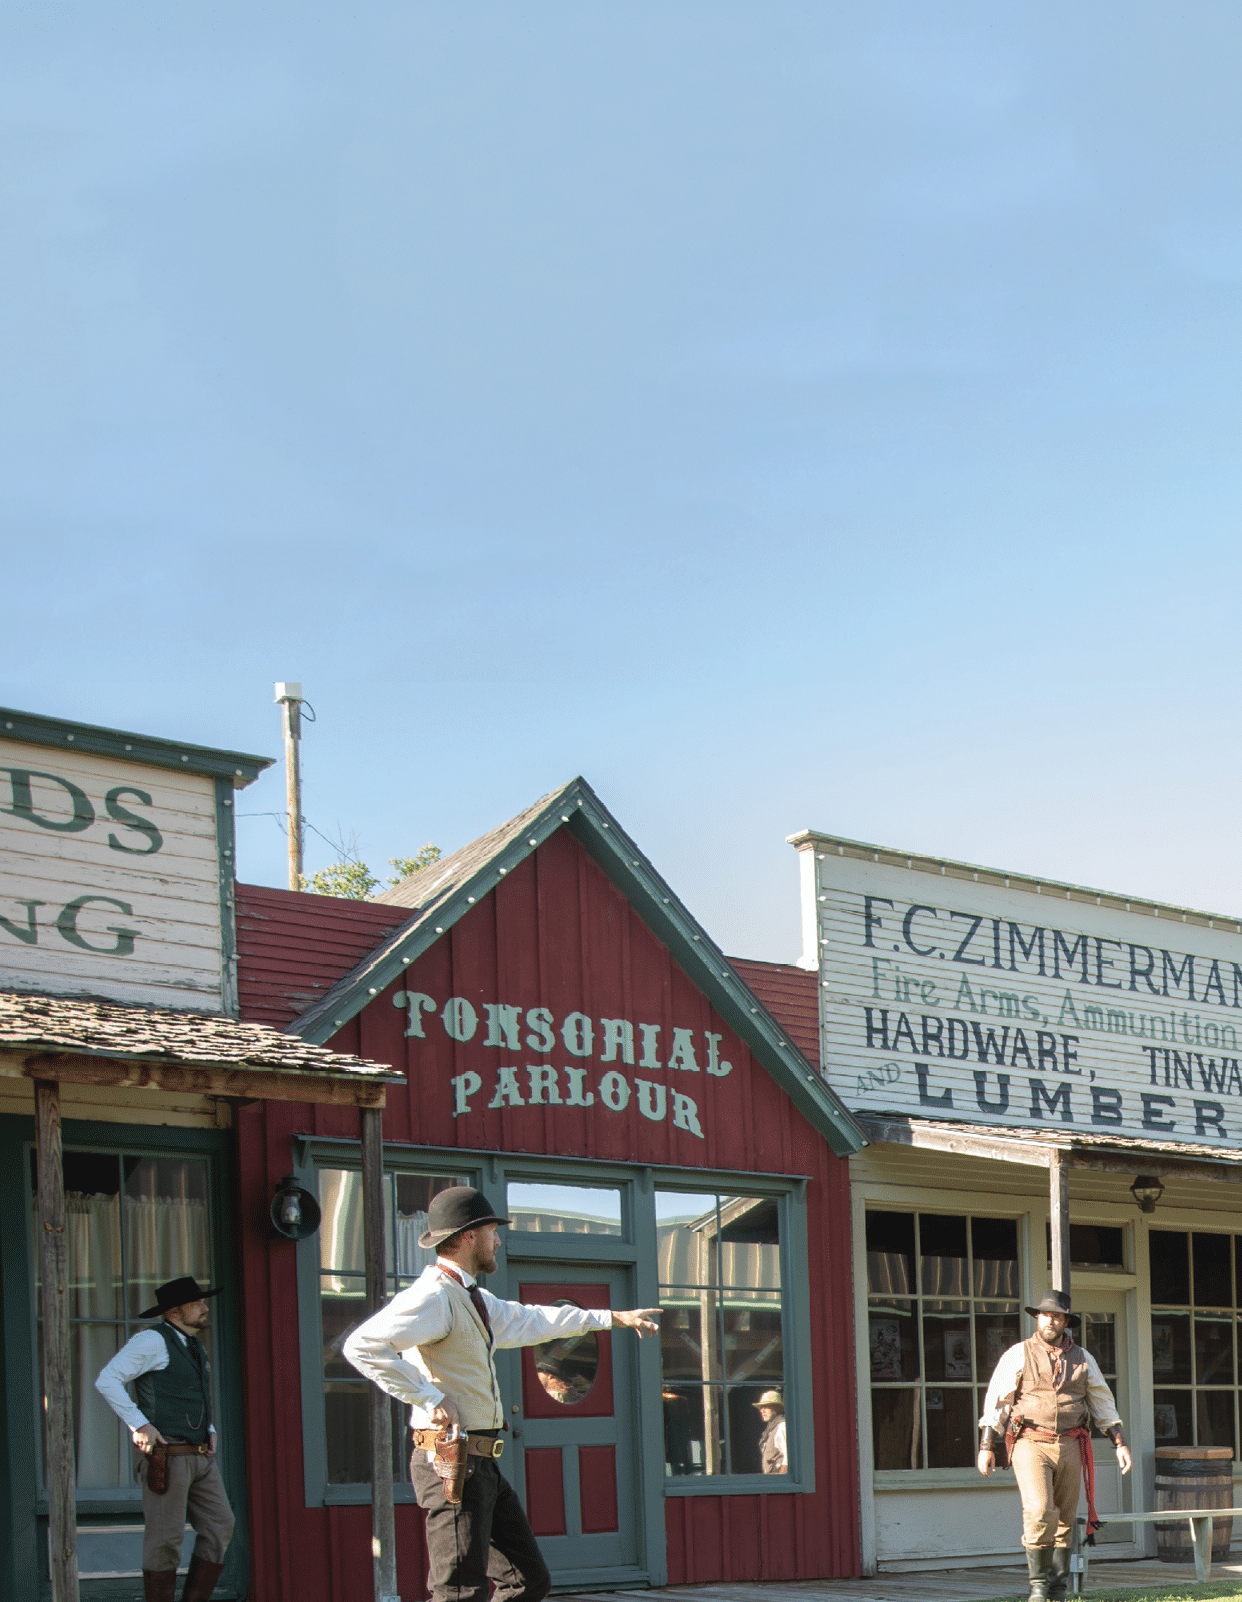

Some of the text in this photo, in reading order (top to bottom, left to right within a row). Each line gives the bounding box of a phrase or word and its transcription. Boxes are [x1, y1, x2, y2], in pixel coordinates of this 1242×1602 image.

[872, 956, 940, 1006] Fire
[953, 971, 1049, 1028] Arms,
[392, 989, 733, 1078] TONSORIAL
[864, 1006, 1096, 1082] HARDWARE,
[451, 1064, 705, 1139] PARLOUR
[855, 1062, 1228, 1139] AND LUMBER
